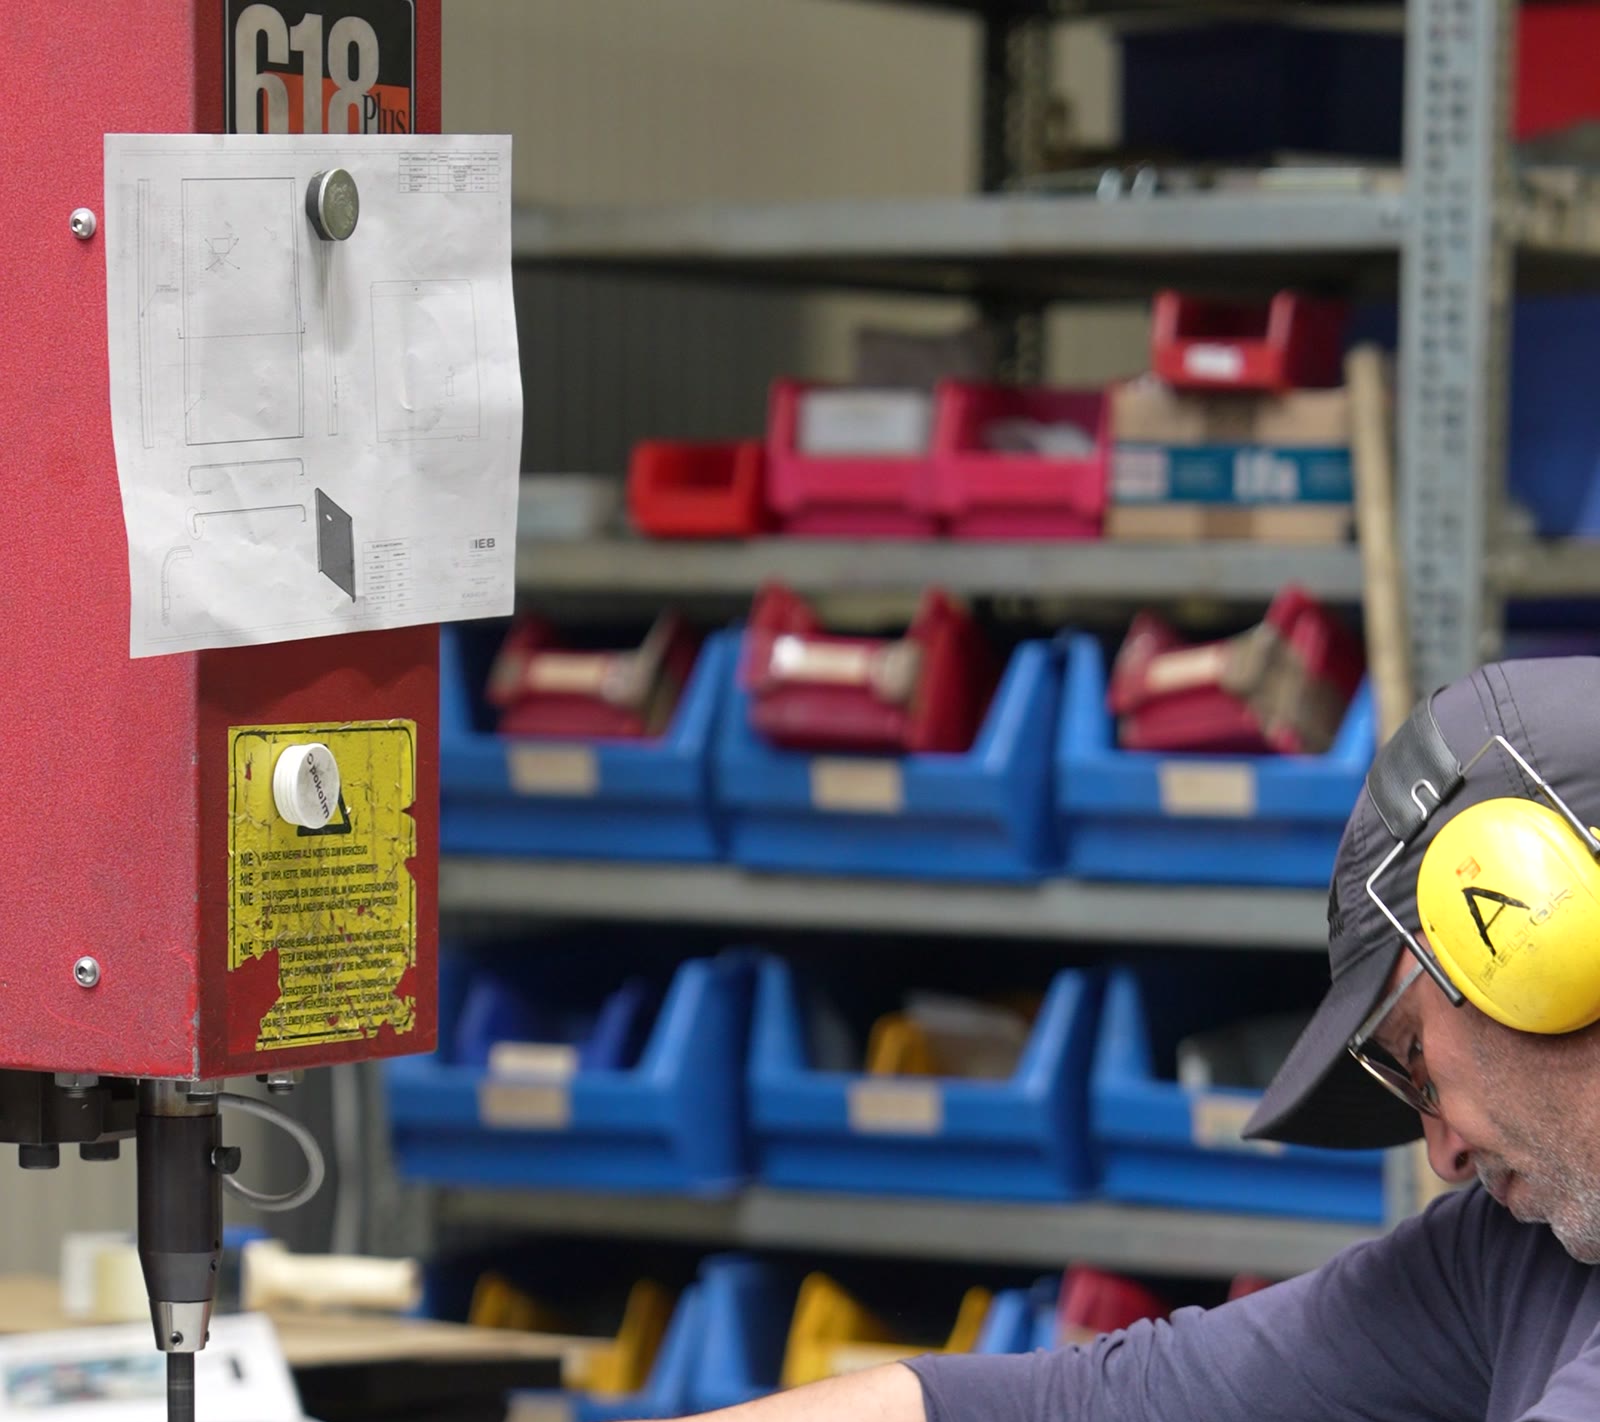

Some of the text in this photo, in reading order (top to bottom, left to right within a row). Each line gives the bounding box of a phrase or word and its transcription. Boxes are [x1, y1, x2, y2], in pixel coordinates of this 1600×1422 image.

[235, 4, 379, 134] 618
[363, 93, 406, 134] Plus
[309, 765, 330, 819] pokolm
[342, 844, 367, 856] WERKZEUG
[1462, 886, 1530, 957] A
